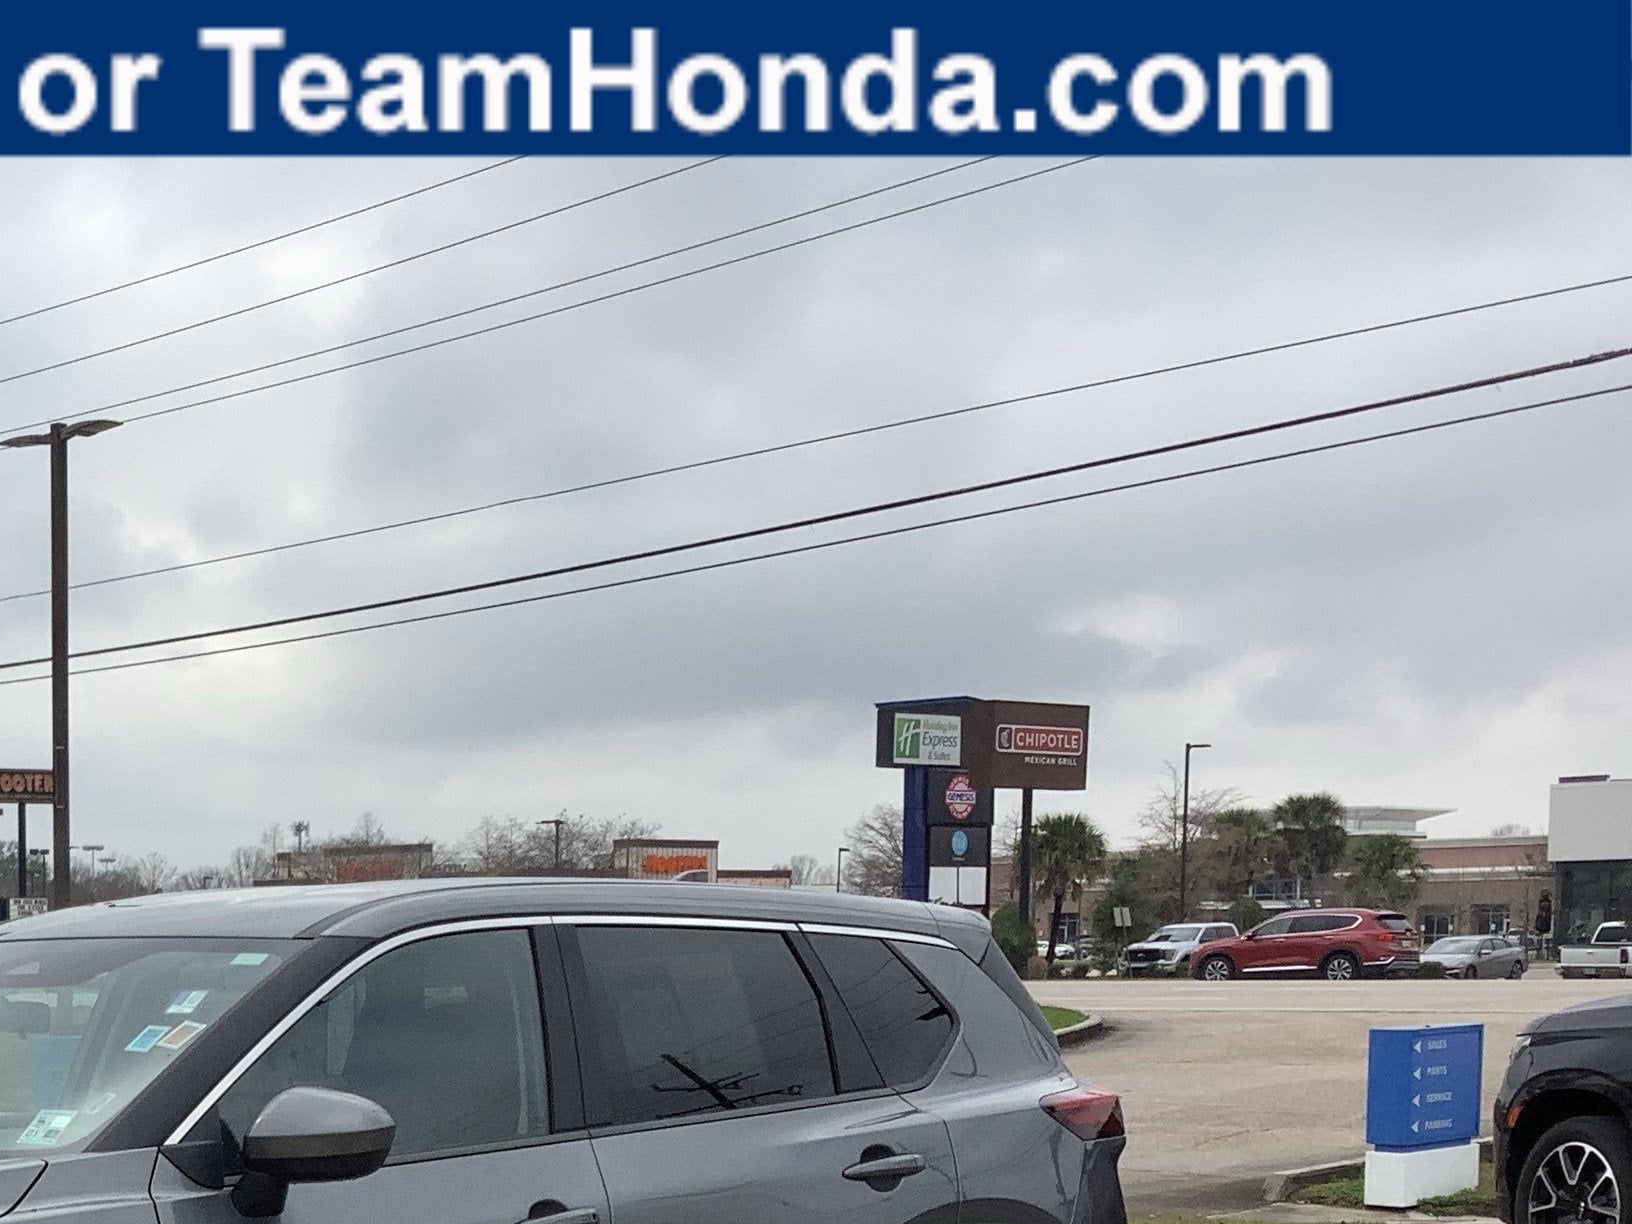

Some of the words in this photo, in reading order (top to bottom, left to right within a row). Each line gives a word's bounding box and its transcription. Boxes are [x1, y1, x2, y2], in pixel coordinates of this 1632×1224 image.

[922, 731, 959, 750] Express
[1016, 732, 1079, 749] CHIPOTLE
[1024, 755, 1056, 765] MEXICAN
[1057, 757, 1077, 766] GRILL
